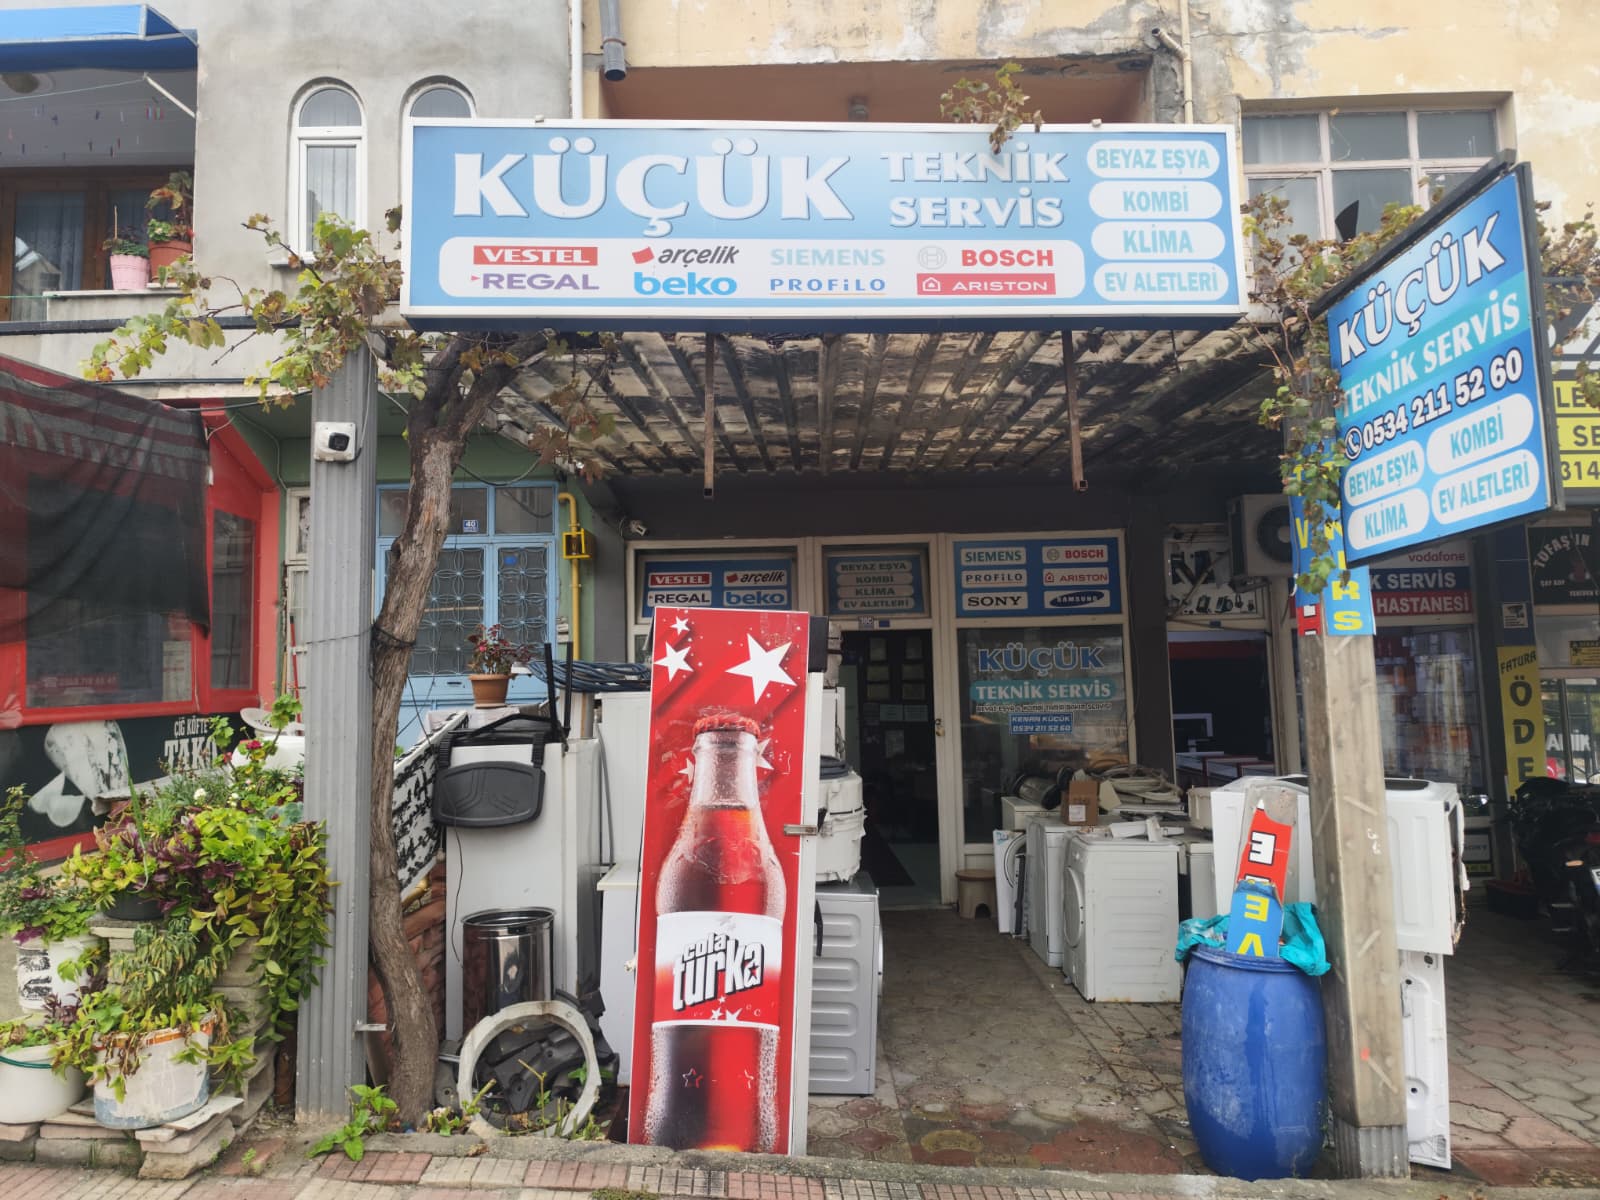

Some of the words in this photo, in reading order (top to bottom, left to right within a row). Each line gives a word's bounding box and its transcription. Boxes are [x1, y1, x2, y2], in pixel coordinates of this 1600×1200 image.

[880, 142, 1070, 183] TEKNİK
[1096, 148, 1156, 169] BEYAZ
[1163, 148, 1210, 174] EŞYA
[453, 137, 855, 238] KÜÇÜK
[889, 187, 1065, 228] SERVİS
[1123, 185, 1189, 213] KOMBİ
[1123, 224, 1194, 254] KLİMA
[482, 248, 591, 264] VESTEL
[657, 246, 740, 268] arçelik
[770, 248, 885, 267] SIEMENS
[961, 249, 1054, 267] BOSCH
[483, 273, 600, 290] REGAL
[634, 271, 737, 296] beko
[952, 280, 1048, 292] ARISTON
[1105, 272, 1128, 292] EV
[1134, 266, 1219, 292] ALETLERİ
[1337, 211, 1506, 367] KÜÇÜK
[1343, 350, 1418, 418] TEKNİK
[1424, 290, 1521, 373] SERVİS
[1361, 413, 1408, 450] 0534
[1411, 381, 1452, 428] 211
[1455, 367, 1487, 408] 52
[1489, 348, 1524, 390] 60
[1449, 406, 1504, 459] KOMBİ
[1348, 463, 1385, 497] BEYAZ
[1386, 450, 1418, 486] EŞYA
[1438, 489, 1458, 516] EV
[1460, 455, 1531, 510] ALETLERİ
[1363, 503, 1408, 541] KLİMA
[965, 551, 1022, 563] SIEMENS
[1065, 549, 1104, 559] BOSCH
[1408, 551, 1465, 562] vodafone
[740, 570, 784, 584] arçelik
[841, 563, 876, 571] BEYAZ
[1059, 573, 1108, 583] ARISTON
[655, 574, 706, 585] VESTEL
[1387, 568, 1456, 589] SERVİS
[654, 592, 711, 604] REGAL
[726, 590, 785, 605] beko
[967, 595, 1021, 607] SONY
[1376, 592, 1470, 614] HASTANESİ
[977, 640, 1105, 677] KÜÇÜK
[1500, 650, 1537, 674] FATURA
[975, 681, 1044, 700] TEKNİK
[1047, 680, 1111, 698] SERVİS
[683, 932, 729, 962] cola
